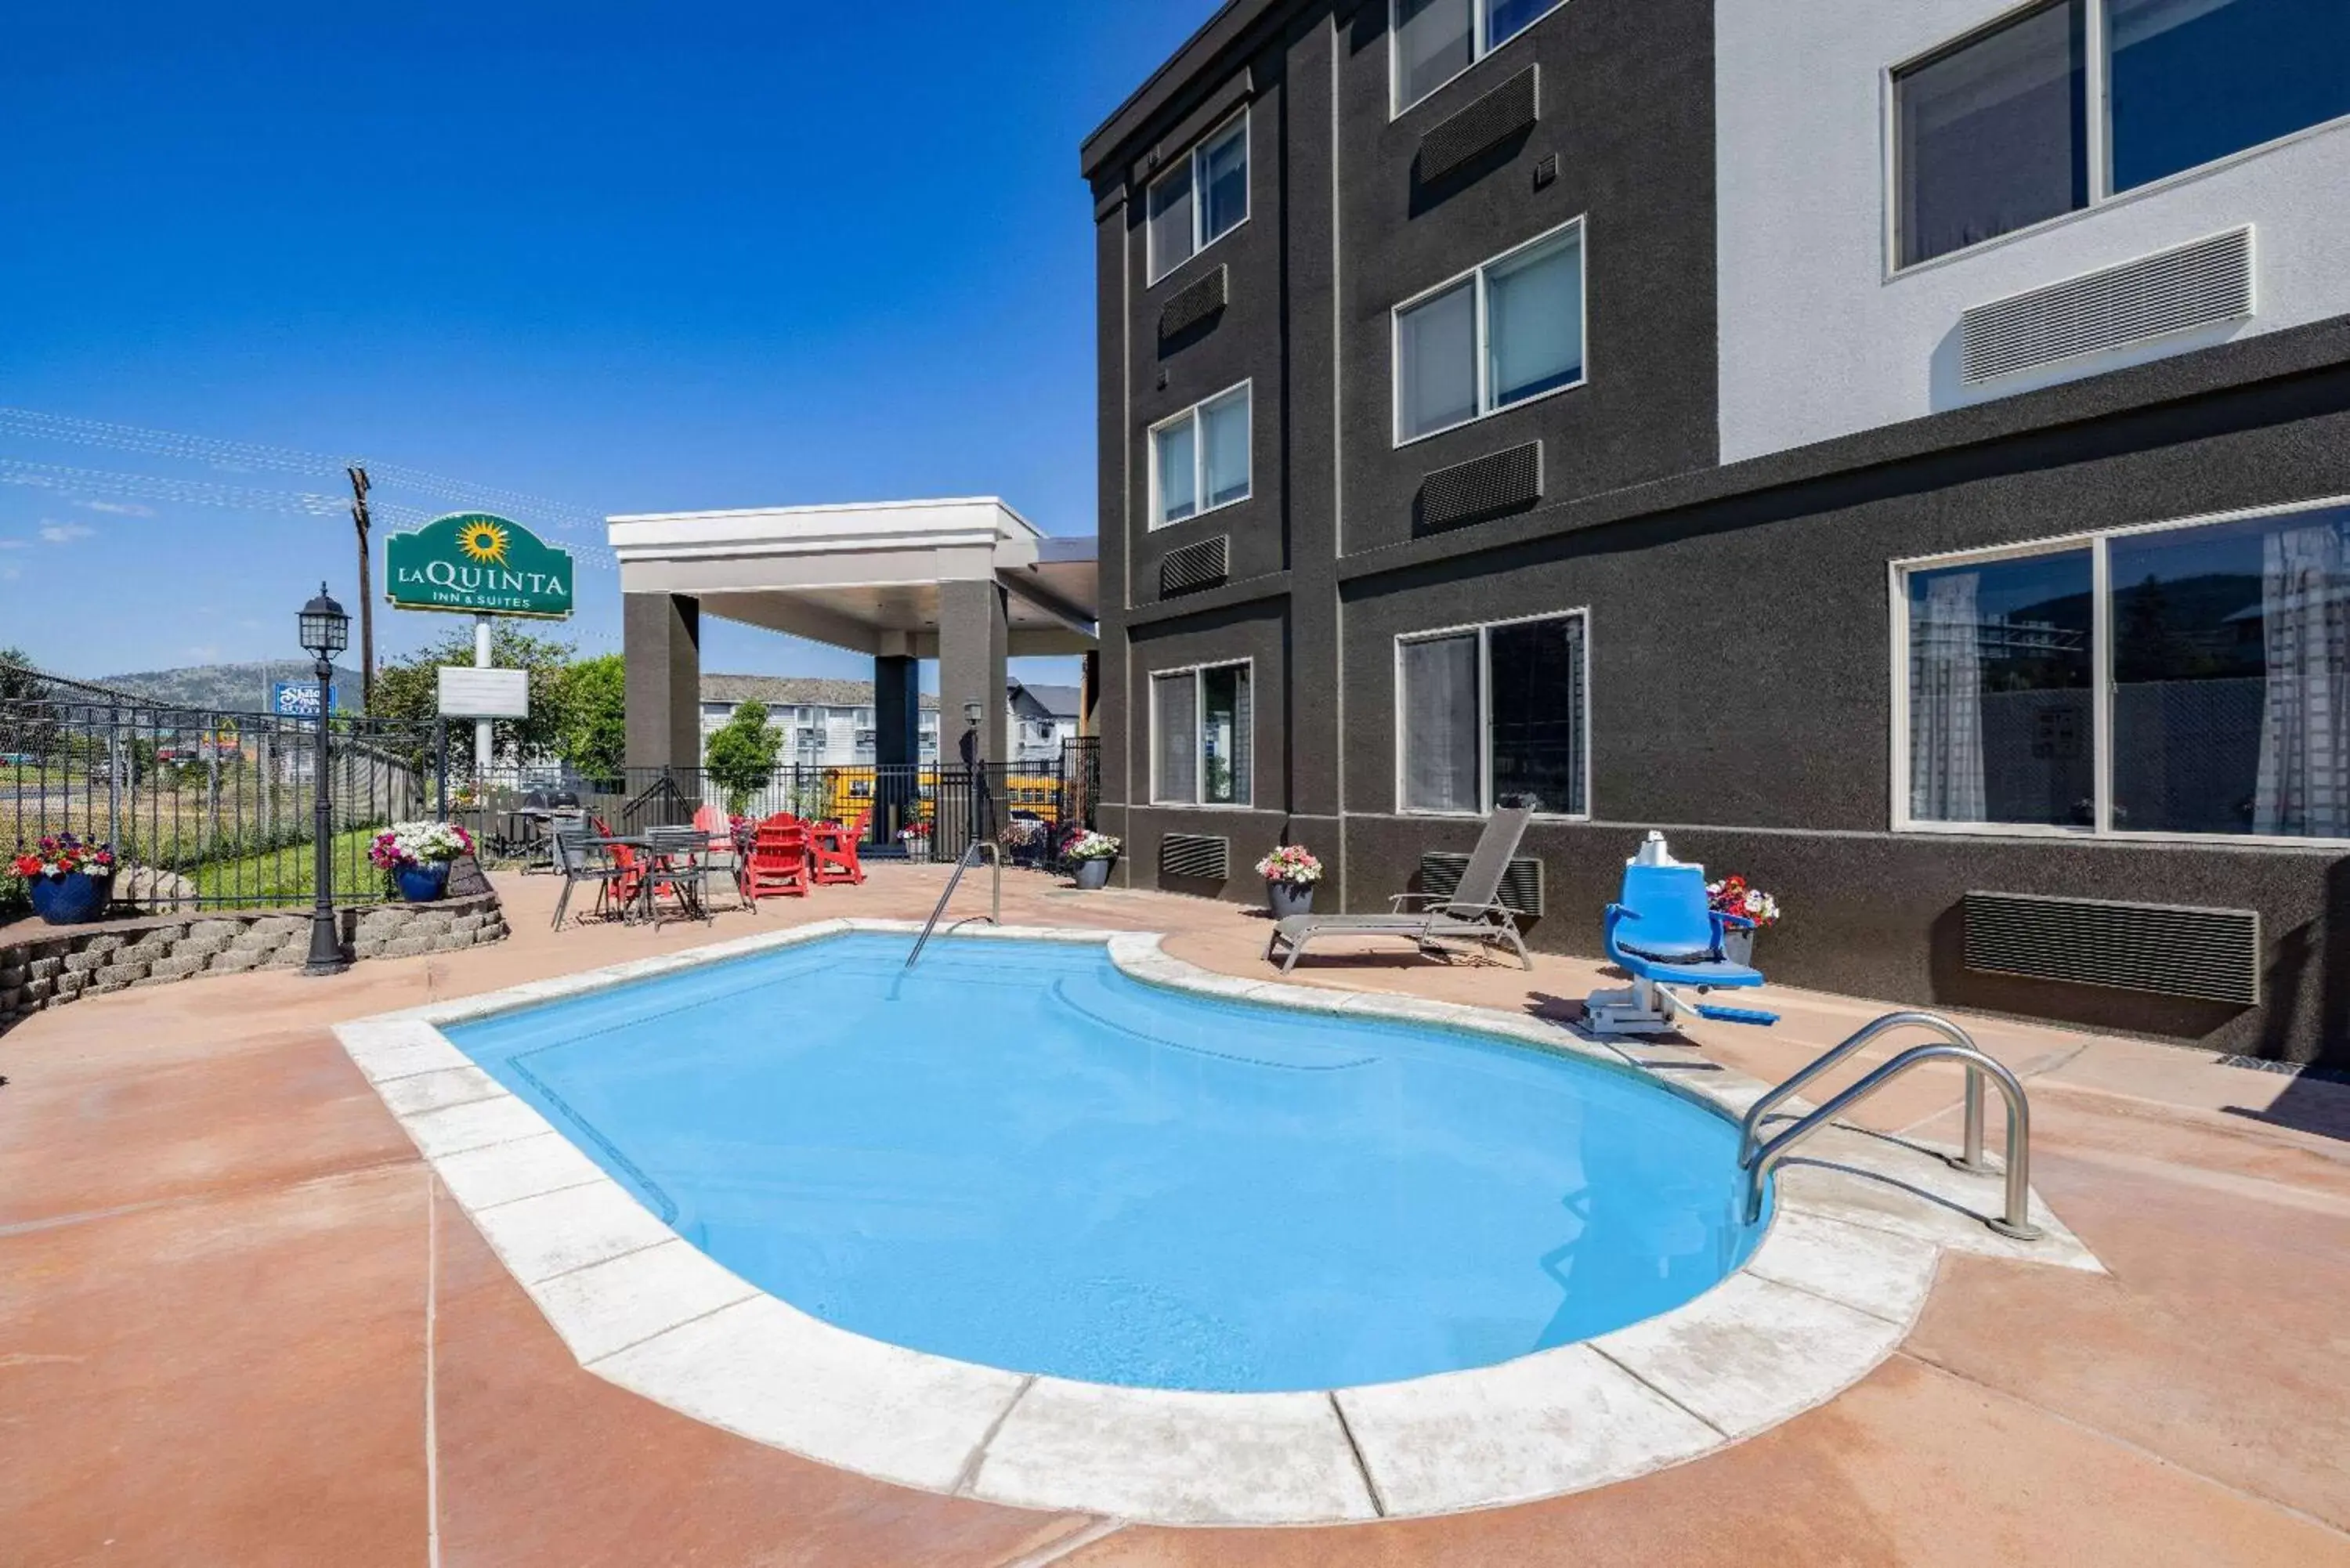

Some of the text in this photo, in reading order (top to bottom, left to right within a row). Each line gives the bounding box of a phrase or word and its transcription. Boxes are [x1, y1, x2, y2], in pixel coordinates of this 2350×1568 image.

[399, 560, 566, 596] LA QUINTA
[433, 591, 530, 609] INN & SUITES
[280, 687, 320, 705] Shilo
